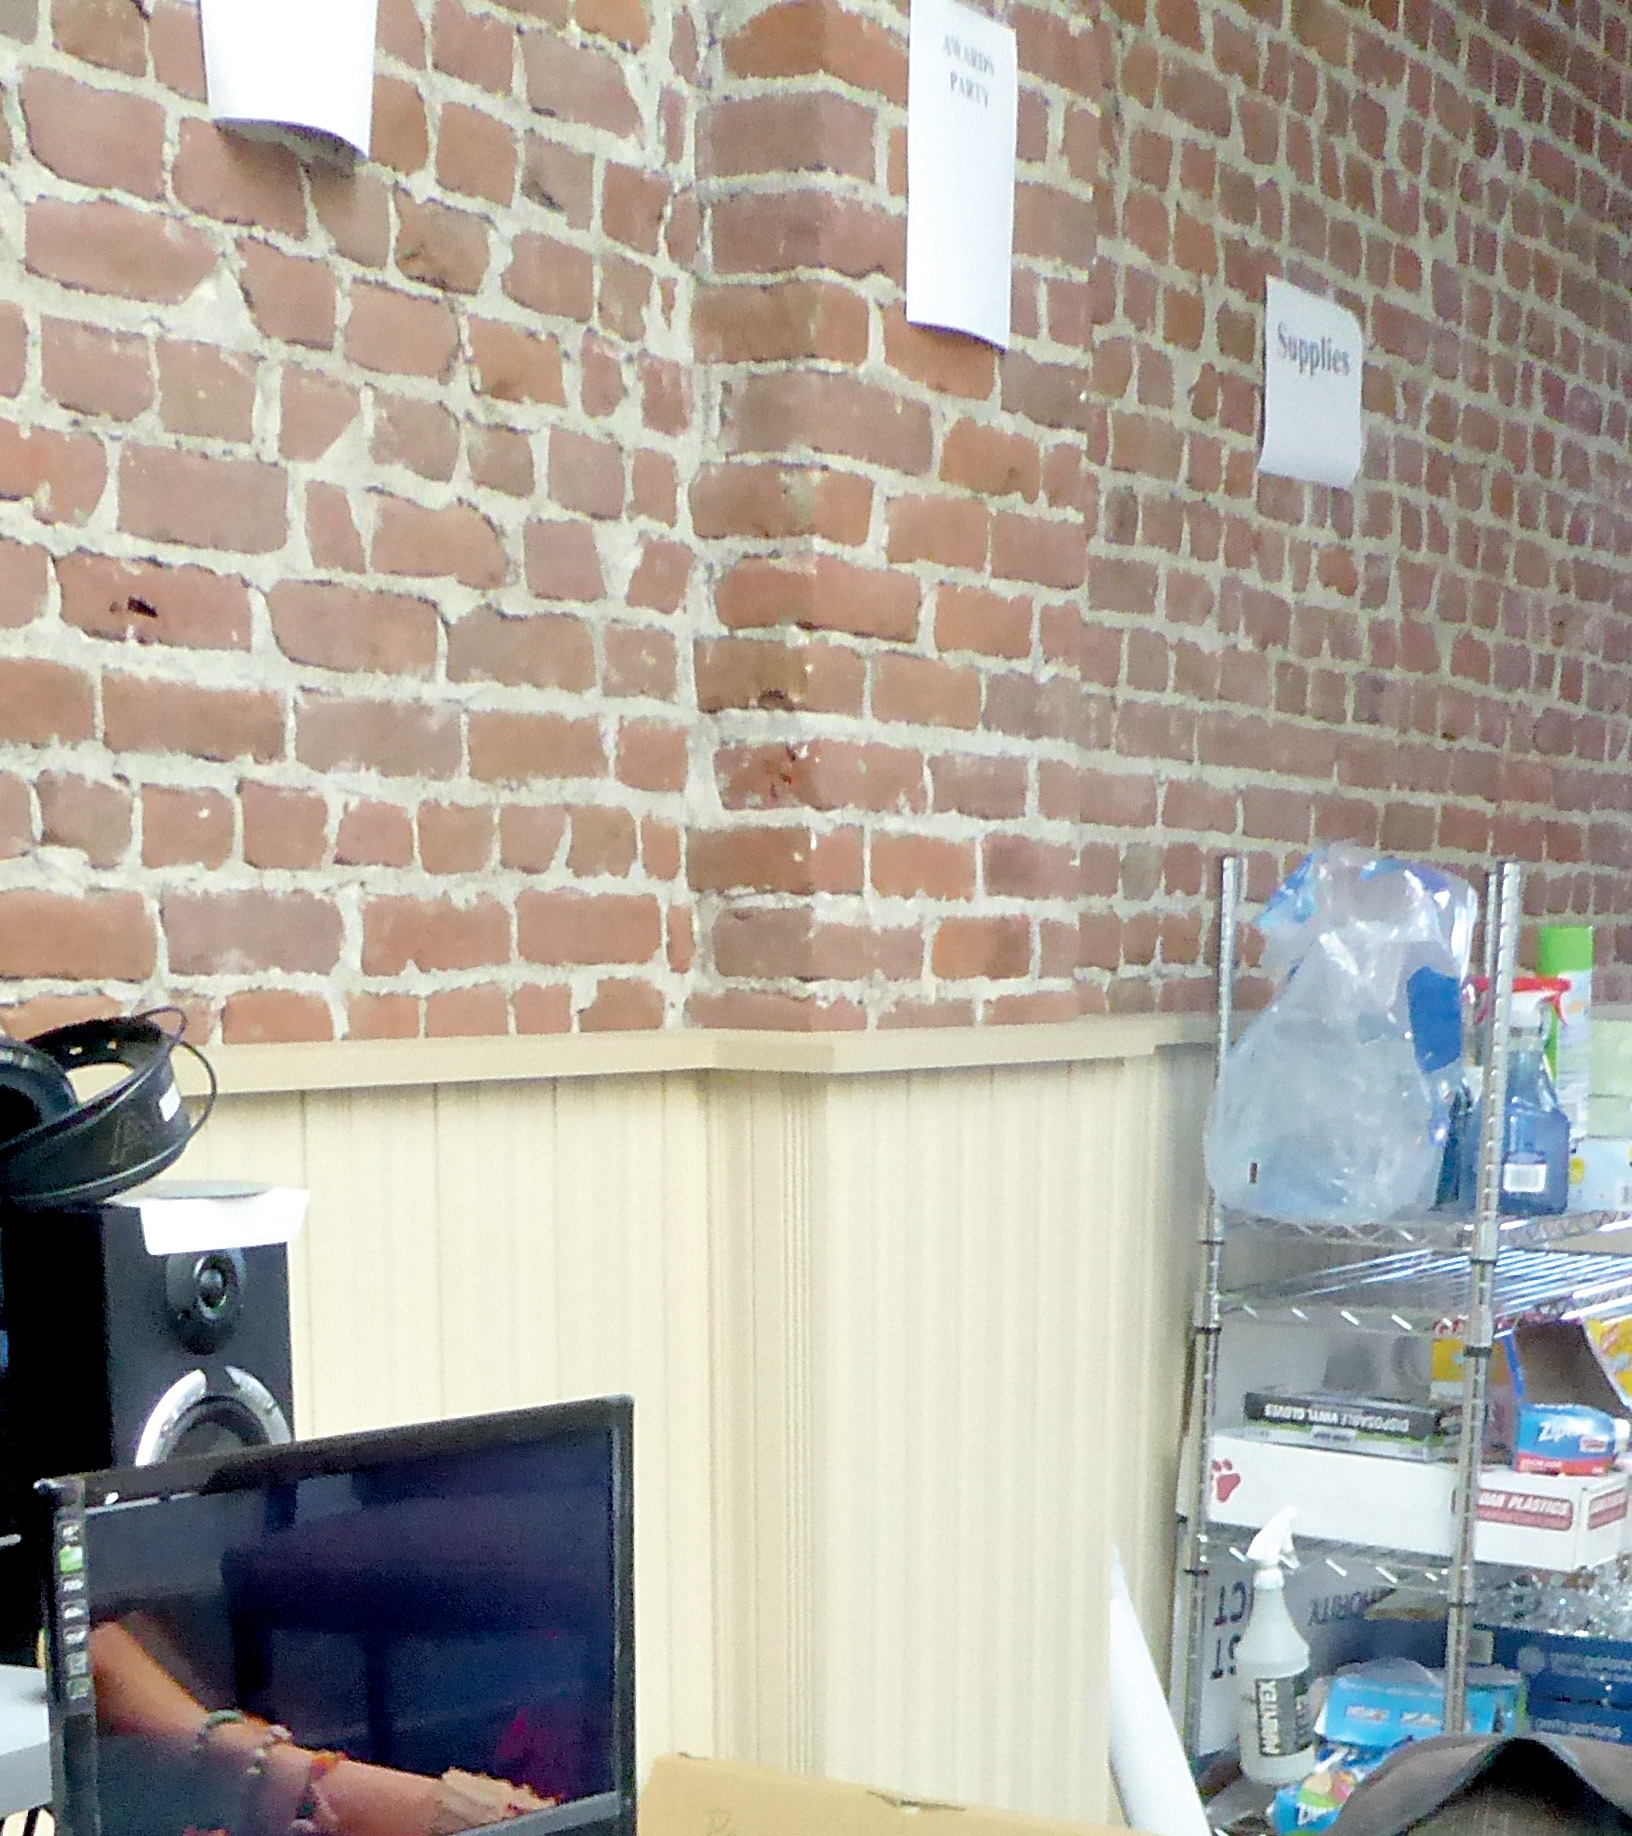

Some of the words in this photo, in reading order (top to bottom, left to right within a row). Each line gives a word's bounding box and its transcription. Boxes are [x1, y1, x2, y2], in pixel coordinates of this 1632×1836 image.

[942, 34, 995, 76] AWARDS
[950, 70, 989, 108] PARTY
[1277, 320, 1350, 377] Supplies
[1507, 1494, 1568, 1517] PLASTICS
